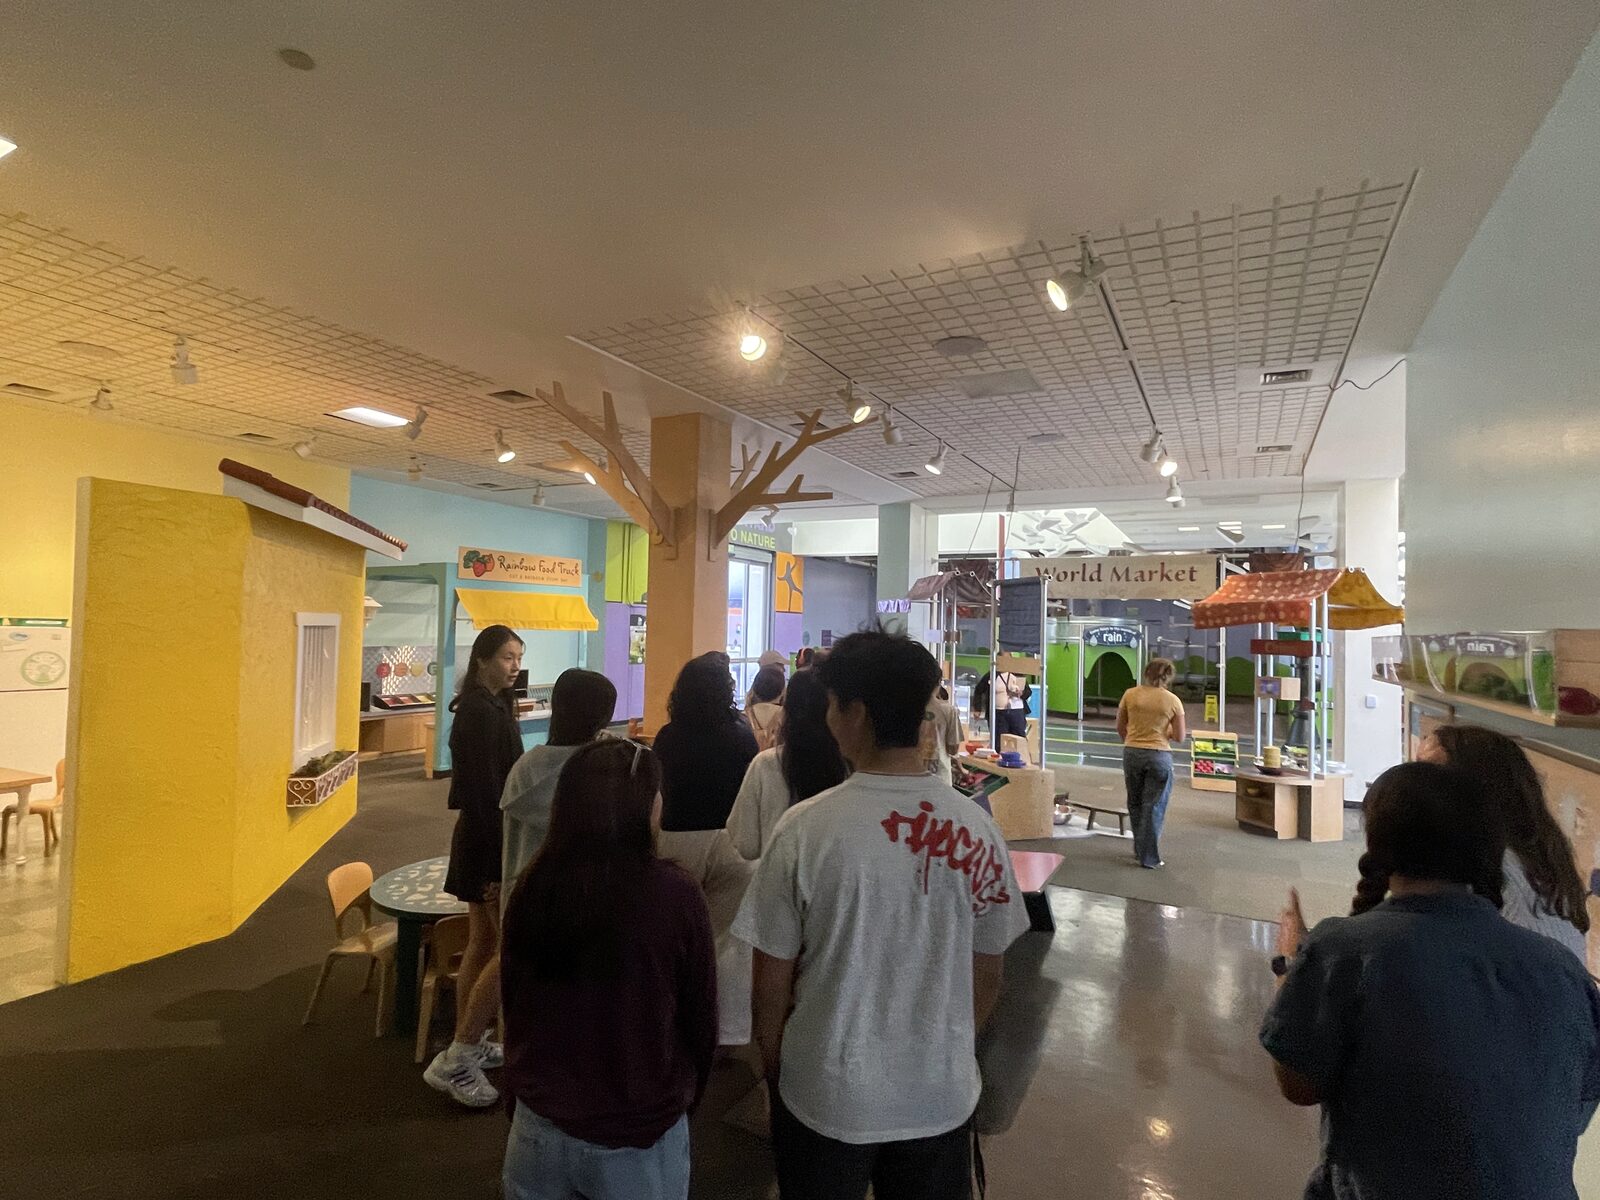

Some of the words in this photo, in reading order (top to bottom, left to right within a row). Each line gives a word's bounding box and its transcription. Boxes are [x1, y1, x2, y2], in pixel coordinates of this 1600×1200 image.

[740, 530, 776, 549] NATURE
[497, 555, 536, 572] Rainbow
[538, 559, 556, 574] Food
[557, 562, 580, 576] Truck
[1035, 563, 1102, 583] World
[1110, 561, 1198, 583] Market
[1103, 631, 1122, 642] rain
